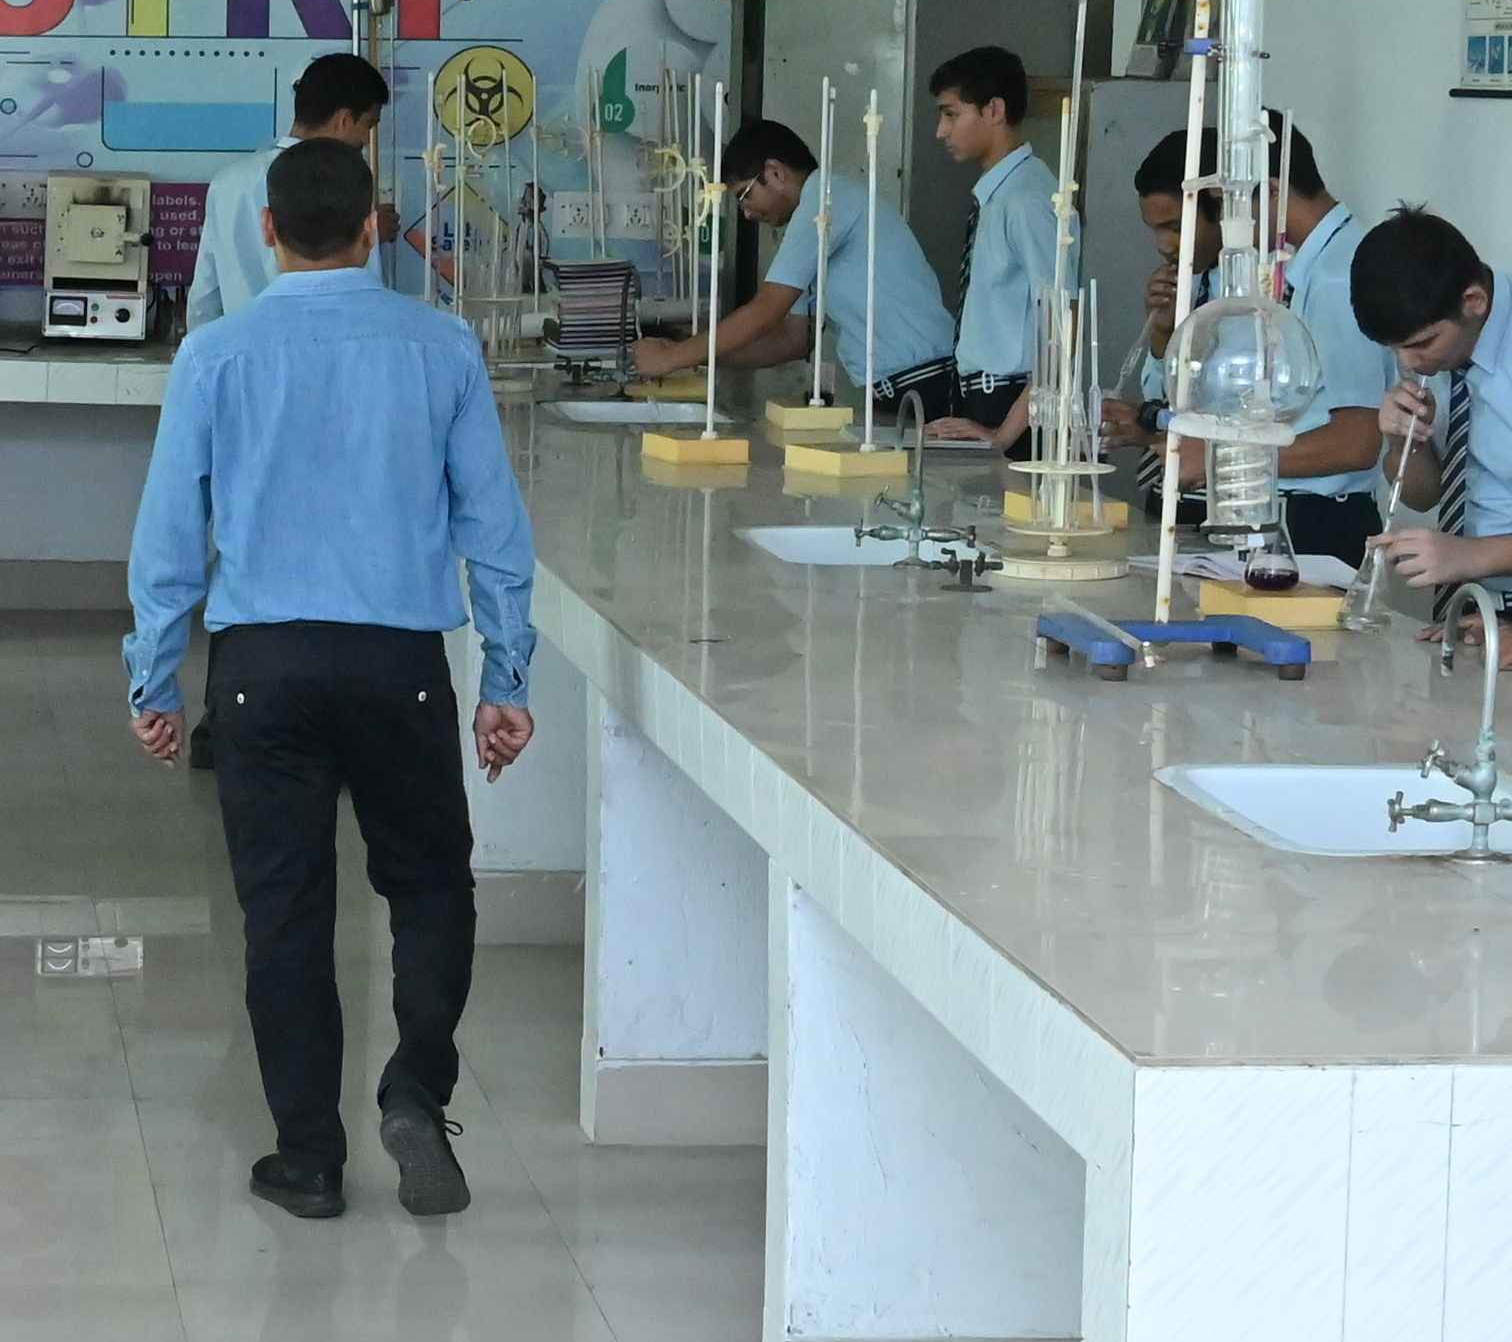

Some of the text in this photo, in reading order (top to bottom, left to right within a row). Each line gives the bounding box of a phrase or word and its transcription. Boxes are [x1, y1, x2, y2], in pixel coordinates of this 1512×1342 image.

[604, 103, 623, 122] 02
[152, 193, 202, 206] labels.
[169, 225, 185, 236] or
[157, 240, 172, 251] to
